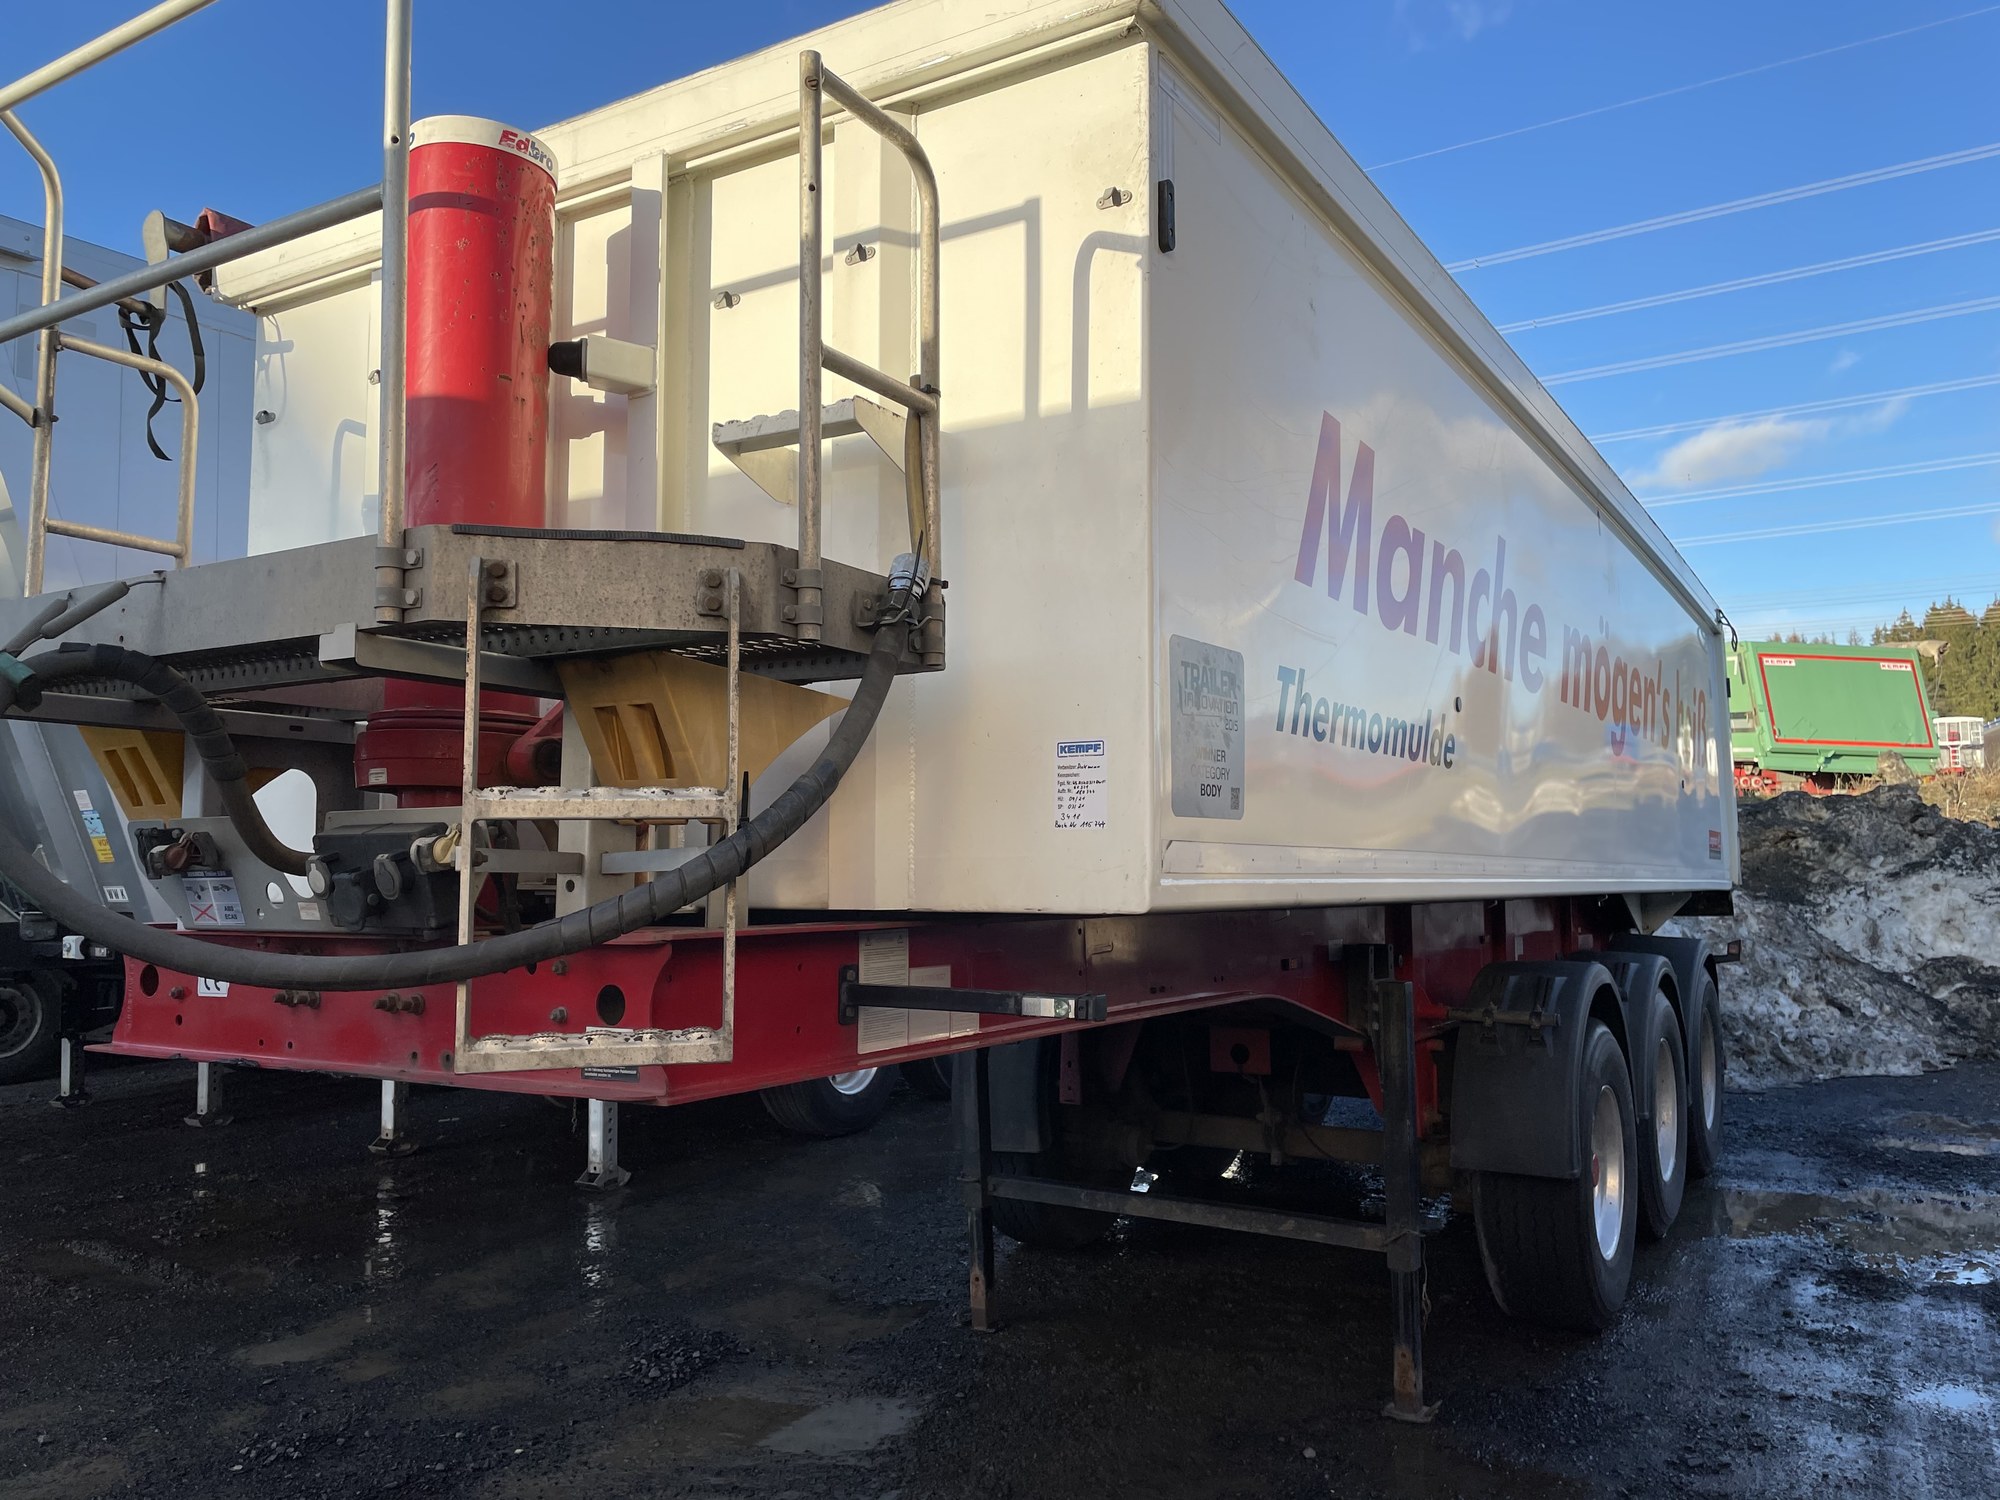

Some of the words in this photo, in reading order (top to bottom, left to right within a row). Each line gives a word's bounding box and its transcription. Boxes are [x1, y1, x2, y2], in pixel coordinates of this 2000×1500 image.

[498, 129, 554, 171] Edbro
[1294, 410, 1547, 694] Manche
[1560, 615, 1671, 756] mögen's
[1181, 660, 1239, 700] TRAILER
[1276, 665, 1456, 769] Thermomulde
[1059, 743, 1102, 754] KEMPF
[1200, 783, 1222, 797] BODY
